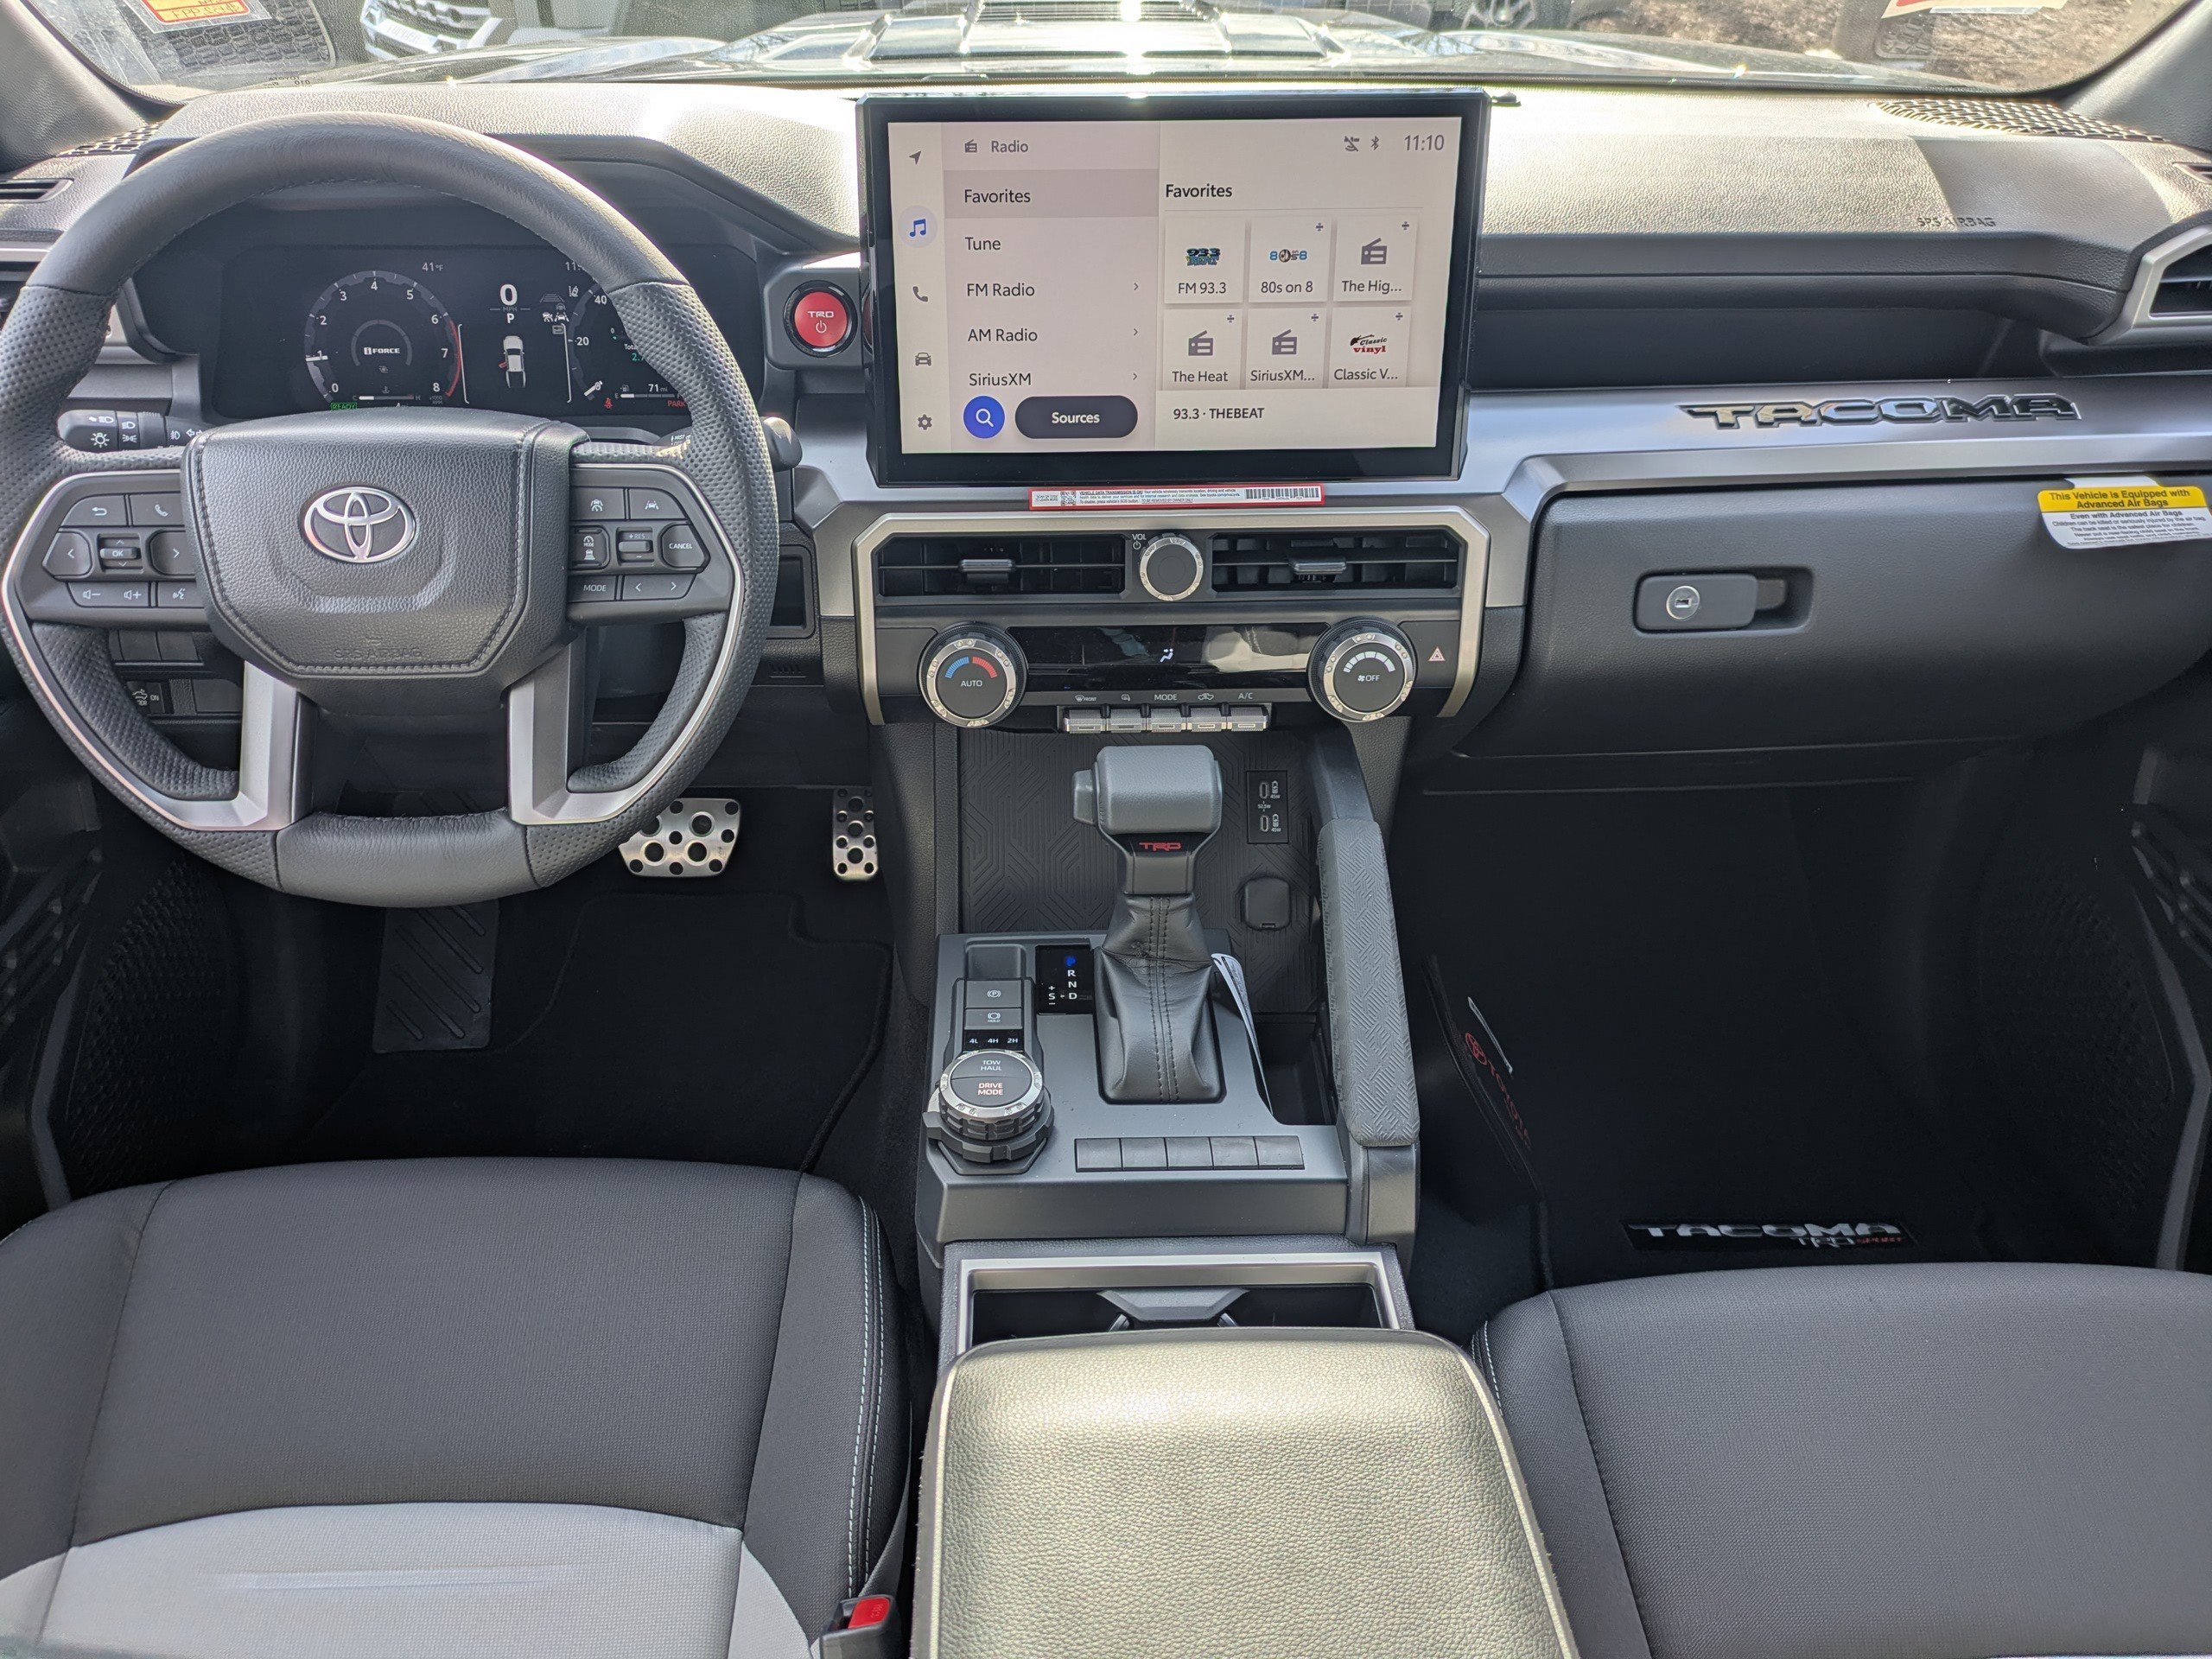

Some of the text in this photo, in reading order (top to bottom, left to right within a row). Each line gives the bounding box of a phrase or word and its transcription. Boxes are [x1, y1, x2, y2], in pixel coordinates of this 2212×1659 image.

[990, 140, 1029, 153] Radio
[1404, 134, 1445, 151] 11:10
[964, 188, 1031, 203] Favorites
[1166, 183, 1233, 198] Favorites
[1917, 217, 1942, 227] SRS
[964, 237, 1001, 251] Tune
[371, 281, 378, 291] 4
[967, 282, 1035, 297] FM Radio
[1178, 282, 1227, 294] FM 93.3
[1261, 281, 1313, 294] 80s on 8
[1342, 280, 1402, 295] The Hig...
[340, 290, 347, 301] 3
[406, 289, 414, 300] 5
[499, 283, 518, 306] 0
[594, 296, 607, 305] 40
[320, 315, 327, 326] 2
[431, 315, 439, 325] 6
[506, 313, 515, 324] P
[967, 327, 1039, 342] AM Radio
[576, 336, 589, 346] 20
[1359, 336, 1388, 346] Classic
[441, 347, 448, 359] 7
[1353, 346, 1387, 354] vinyl
[969, 372, 1032, 386] SiriusXM
[1172, 371, 1229, 382] The Heat
[1250, 369, 1315, 382] SiriusXM...
[1333, 368, 1398, 380] Classic V...
[331, 383, 339, 393] 0
[433, 382, 441, 392] 8
[648, 384, 659, 392] 71
[332, 402, 358, 410] READY
[1676, 392, 2082, 429] TACOMA
[1051, 411, 1101, 423] Sources
[1173, 407, 1265, 420] 93.3 THEBEAT
[2072, 491, 2108, 499] Vehicle
[2121, 490, 2167, 500] Equipped
[2076, 500, 2125, 509] Advanced
[2144, 499, 2169, 509] Bags
[1139, 842, 1182, 852] TRD
[1067, 969, 1077, 977] R
[1068, 980, 1077, 988] N
[1048, 992, 1056, 1001] S
[1068, 992, 1077, 1001] D
[1628, 1222, 1901, 1237] TACOMA
